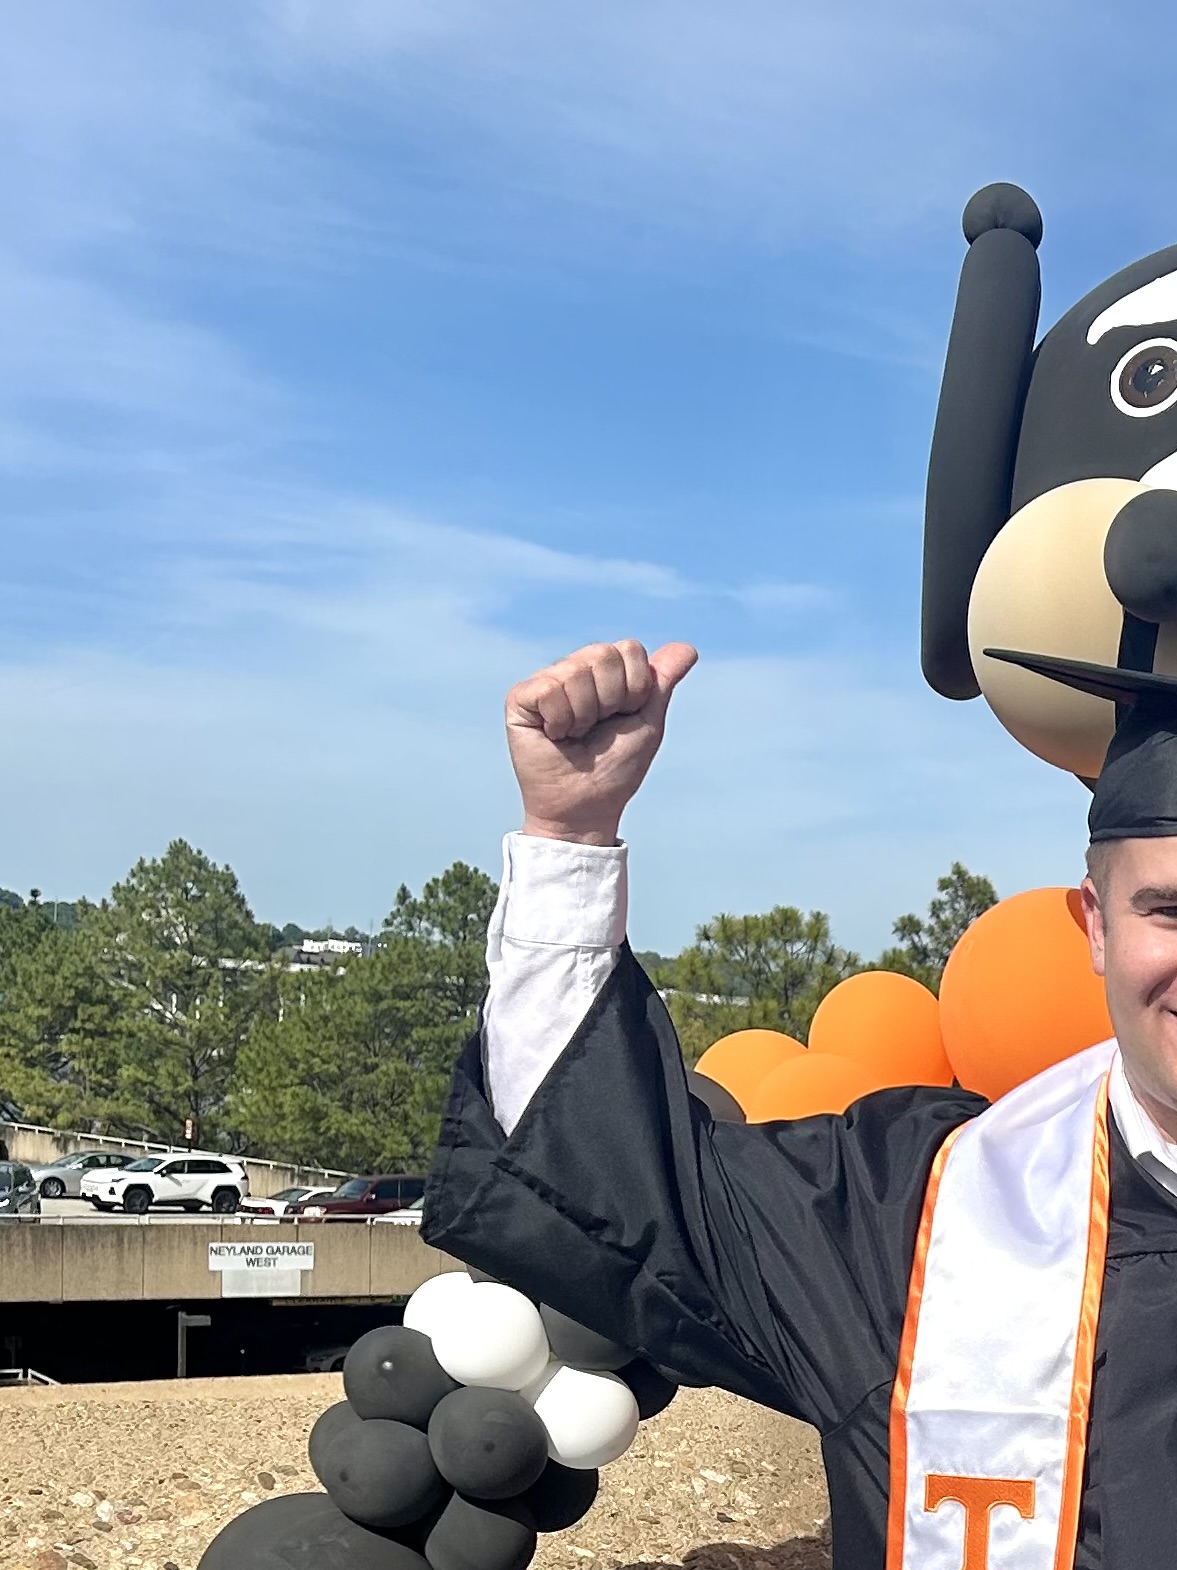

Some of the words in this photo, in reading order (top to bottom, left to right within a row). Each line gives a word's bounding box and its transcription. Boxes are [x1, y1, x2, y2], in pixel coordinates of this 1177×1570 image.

[209, 1245, 263, 1256] NEYLAND
[265, 1245, 313, 1256] GARAGE
[245, 1257, 278, 1268] WEST
